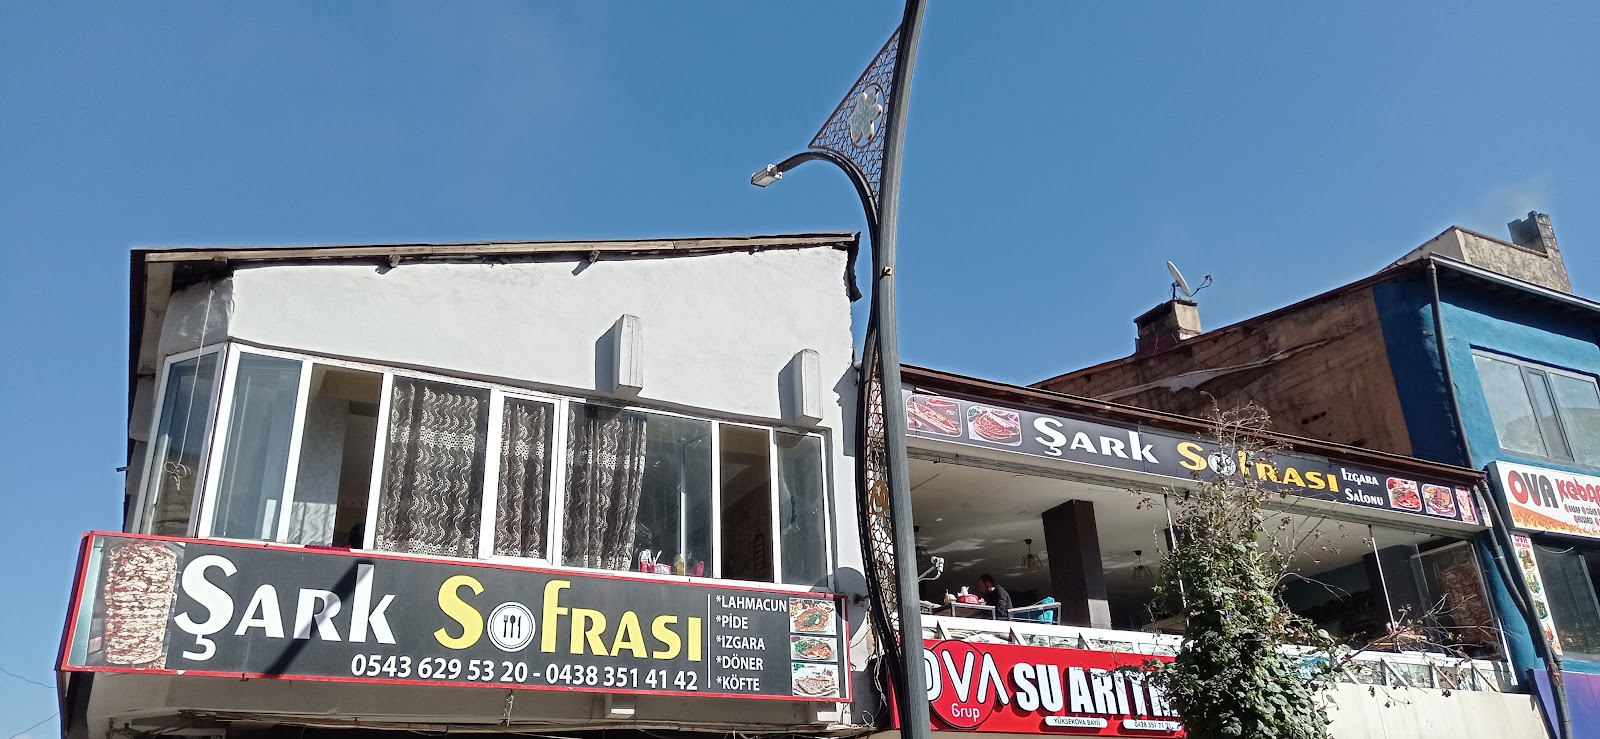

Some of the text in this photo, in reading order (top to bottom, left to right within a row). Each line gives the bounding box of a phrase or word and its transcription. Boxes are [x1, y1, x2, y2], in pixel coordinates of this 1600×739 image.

[1507, 470, 1559, 508] OVA
[351, 653, 412, 678] 0543
[417, 656, 462, 680] 629
[466, 659, 495, 681] 53
[500, 661, 528, 683] 20
[545, 664, 598, 686] 0438
[602, 666, 638, 688] 351
[644, 668, 668, 689] 41
[673, 670, 698, 691] 42
[1013, 662, 1064, 712] SU
[951, 703, 980, 722] Grup
